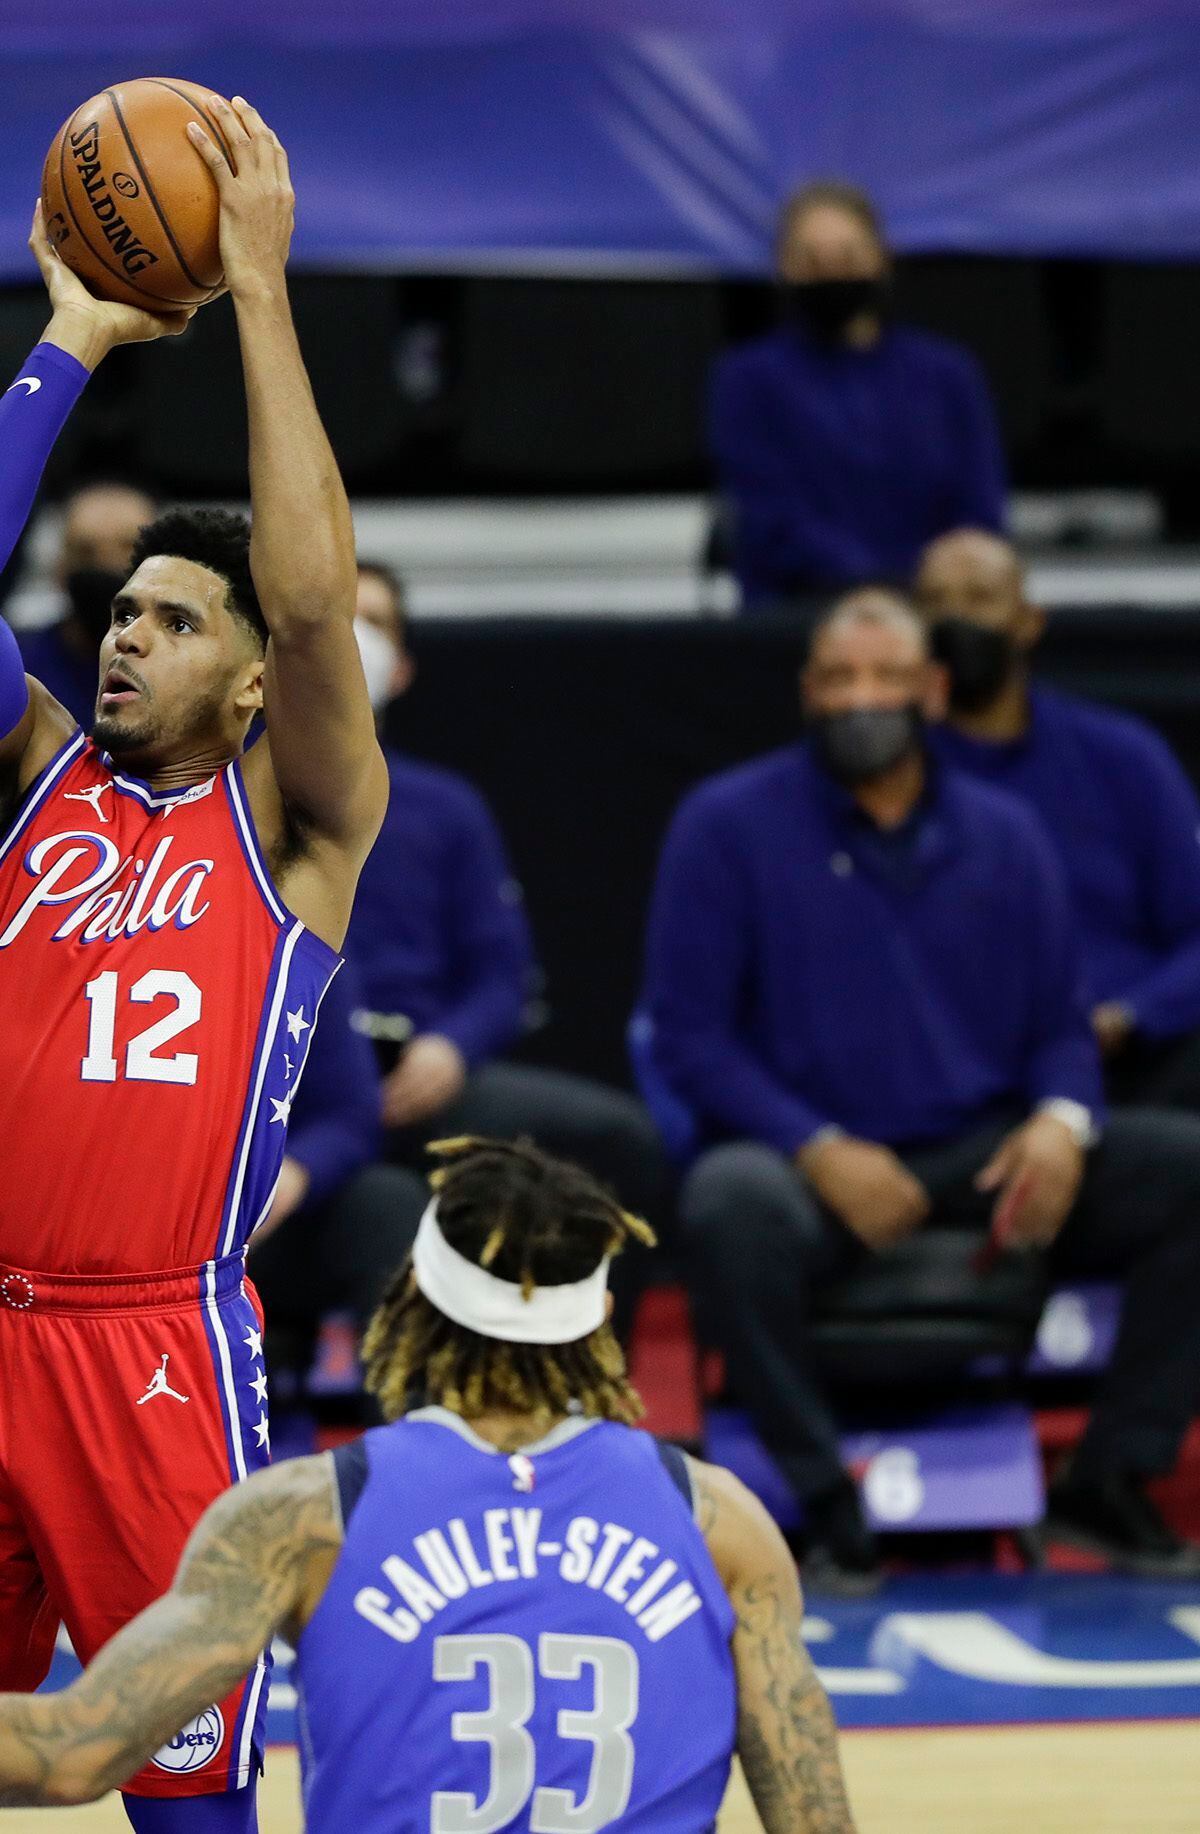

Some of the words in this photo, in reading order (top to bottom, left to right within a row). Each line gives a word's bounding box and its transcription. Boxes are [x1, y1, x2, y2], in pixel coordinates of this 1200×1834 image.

[70, 121, 159, 280] SPALDING
[80, 968, 203, 1086] 12
[353, 1507, 703, 1644] CAULEY-STEIN
[430, 1631, 640, 1834] 33
